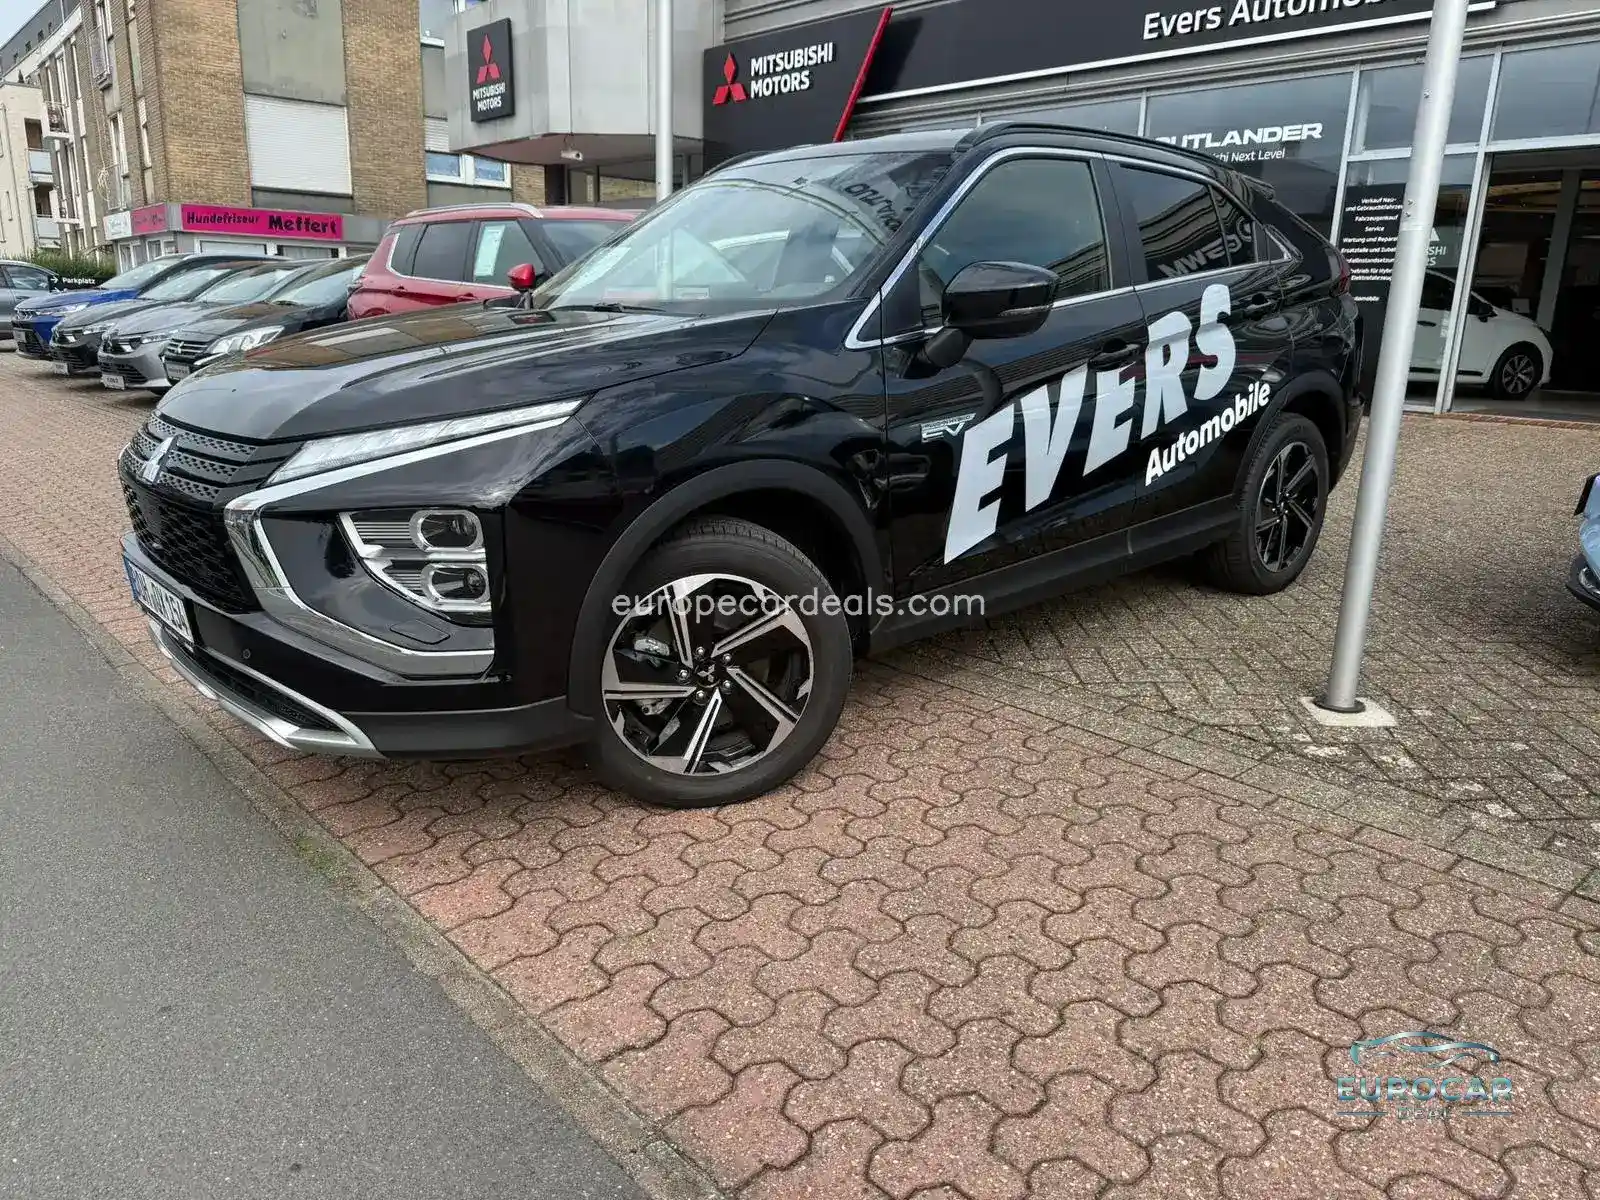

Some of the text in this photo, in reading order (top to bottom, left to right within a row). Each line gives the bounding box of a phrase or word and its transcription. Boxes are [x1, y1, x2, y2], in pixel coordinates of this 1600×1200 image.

[1143, 8, 1221, 40] Evers
[751, 42, 834, 77] MITSUBISHI
[472, 82, 505, 101] MITSUBISHI
[750, 69, 810, 99] MOTORS
[477, 95, 502, 112] MOTORS
[1231, 150, 1256, 162] Next
[1258, 148, 1286, 160] Level
[187, 211, 259, 225] Hundefriseur
[62, 276, 96, 285] Parkplatz
[944, 284, 1236, 564] EVERS
[1145, 380, 1271, 486] Automobile
